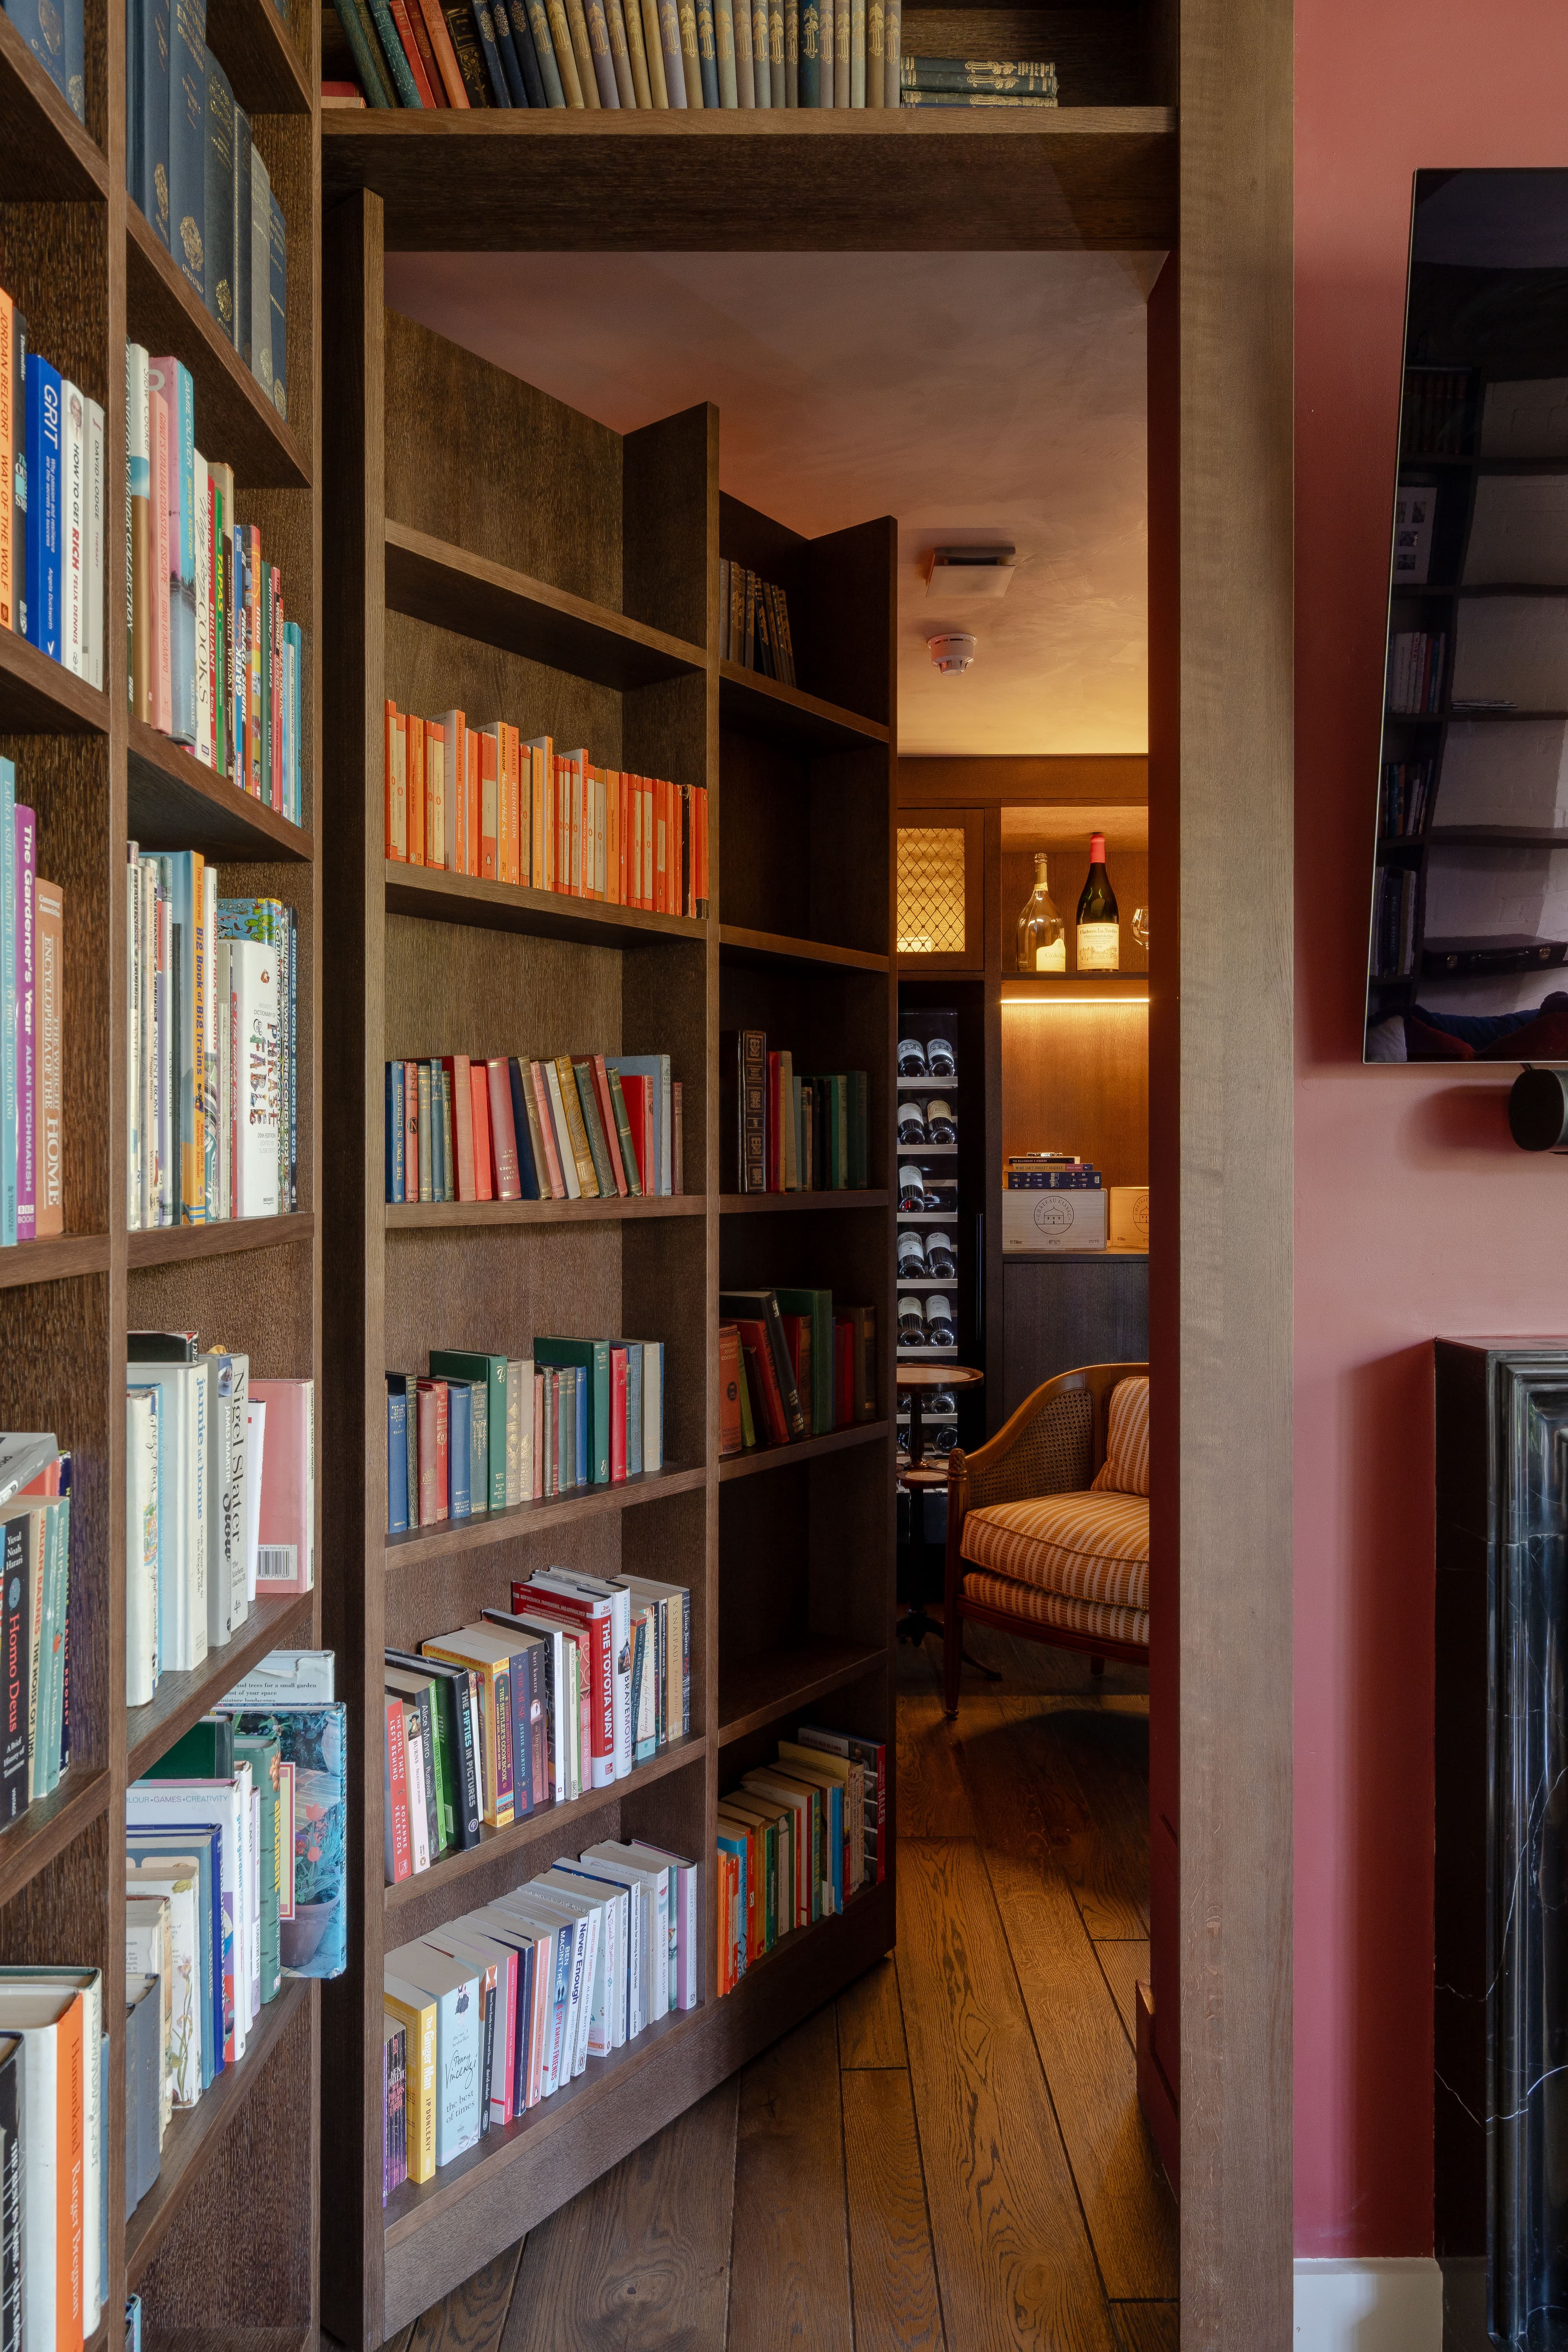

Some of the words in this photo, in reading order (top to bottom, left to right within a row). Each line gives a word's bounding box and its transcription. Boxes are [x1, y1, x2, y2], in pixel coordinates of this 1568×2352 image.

[182, 264, 203, 294] OXFORD
[44, 385, 58, 449] GRIT
[74, 481, 79, 500] TO
[198, 601, 208, 704] COOKS
[24, 869, 32, 983] Gardener's
[44, 937, 52, 1053] ENCYCLOPEDIA
[254, 1009, 270, 1018] DICTIONARY
[47, 1116, 59, 1205] HOME
[1058, 1199, 1071, 1217] CISSAC
[196, 1377, 206, 1446] jamie
[232, 1368, 245, 1448] Nigel
[198, 1448, 203, 1464] at
[232, 1455, 244, 1543] Slater
[7, 1532, 22, 1546] Yuval
[7, 1544, 22, 1558] Noah
[6, 1555, 23, 1570] Harari
[9, 1613, 20, 1678] Homo
[602, 1620, 610, 1649] THE
[603, 1650, 611, 1709] TOYOTA
[9, 1680, 20, 1733] Deus
[461, 1689, 469, 1710] THE
[463, 1710, 472, 1748] FIFTIES
[604, 1711, 612, 1739] WAY
[466, 1761, 476, 1808] PICTURES
[577, 1923, 587, 1957] Never
[557, 1931, 566, 1987] MACINTYRE
[572, 1960, 583, 2005] Enough
[422, 2031, 434, 2064] Ginger
[452, 2035, 469, 2048] bestseller
[423, 2065, 434, 2090] Man
[551, 2051, 559, 2081] FRIENDS
[71, 2038, 80, 2158] Humankind
[446, 2101, 457, 2112] the
[459, 2090, 474, 2103] best
[455, 2101, 475, 2117] times
[70, 2159, 81, 2227] Rutger
[71, 2230, 81, 2320] Bregman
